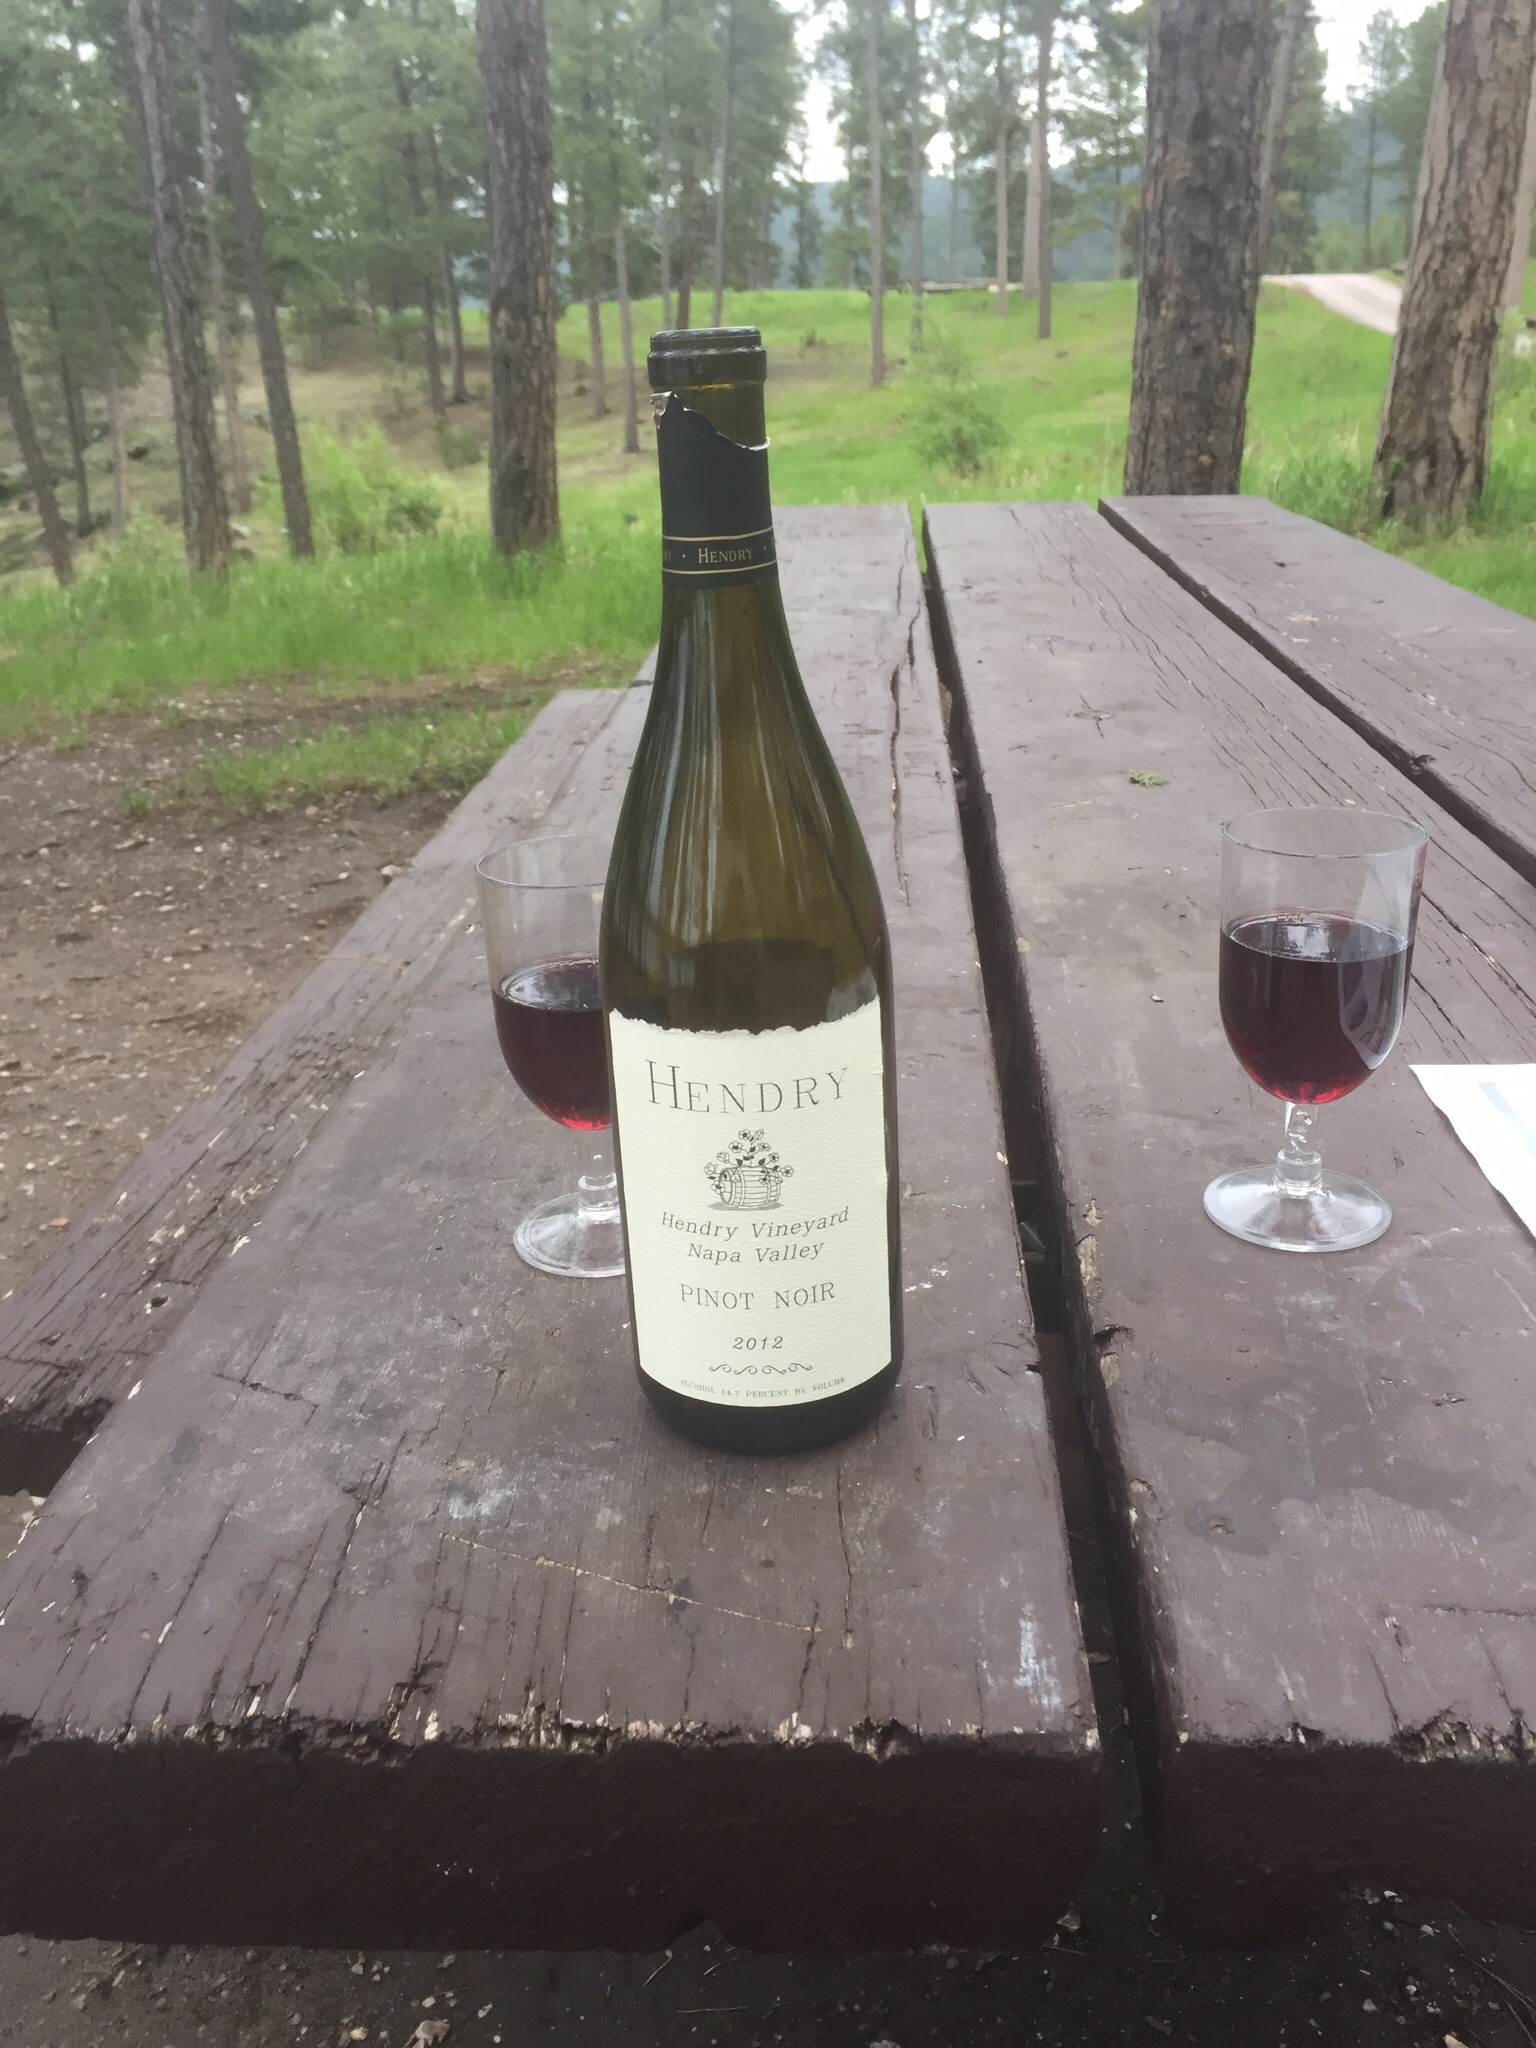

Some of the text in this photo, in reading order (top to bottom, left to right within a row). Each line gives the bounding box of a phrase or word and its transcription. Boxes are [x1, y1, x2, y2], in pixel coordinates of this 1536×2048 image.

[698, 547, 754, 564] HENDRY
[644, 1058, 850, 1114] HENDRY
[660, 1206, 850, 1241] Hendry Vineyard
[687, 1241, 825, 1265] Napa Valley
[679, 1281, 836, 1311] PINOT NOIR
[732, 1335, 784, 1351] 2012
[679, 1378, 716, 1394] ALCOHOL
[746, 1389, 789, 1398] PERCENT
[795, 1386, 807, 1396] BY
[812, 1376, 846, 1391] VOLUME
